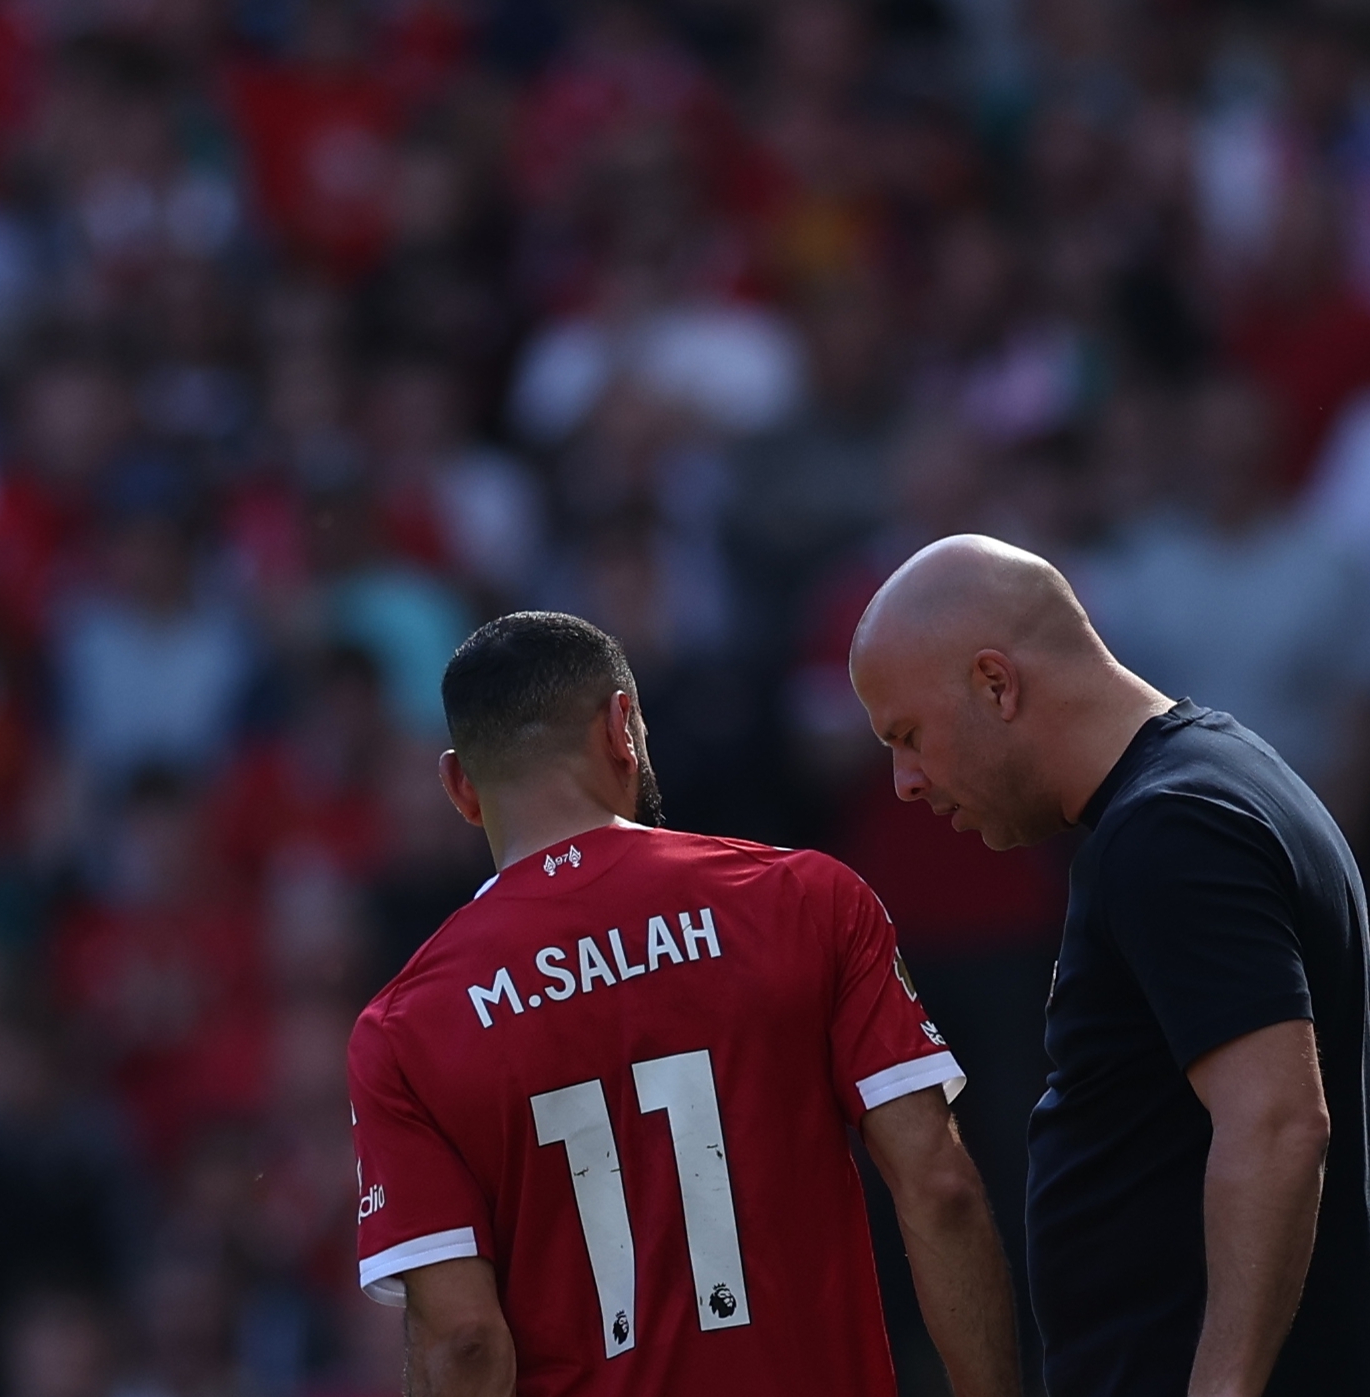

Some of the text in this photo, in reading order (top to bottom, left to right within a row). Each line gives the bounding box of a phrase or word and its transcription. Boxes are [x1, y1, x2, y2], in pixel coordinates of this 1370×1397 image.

[554, 853, 570, 866] 97
[467, 907, 721, 1029] M.SALAH
[529, 1048, 751, 1360] 11
